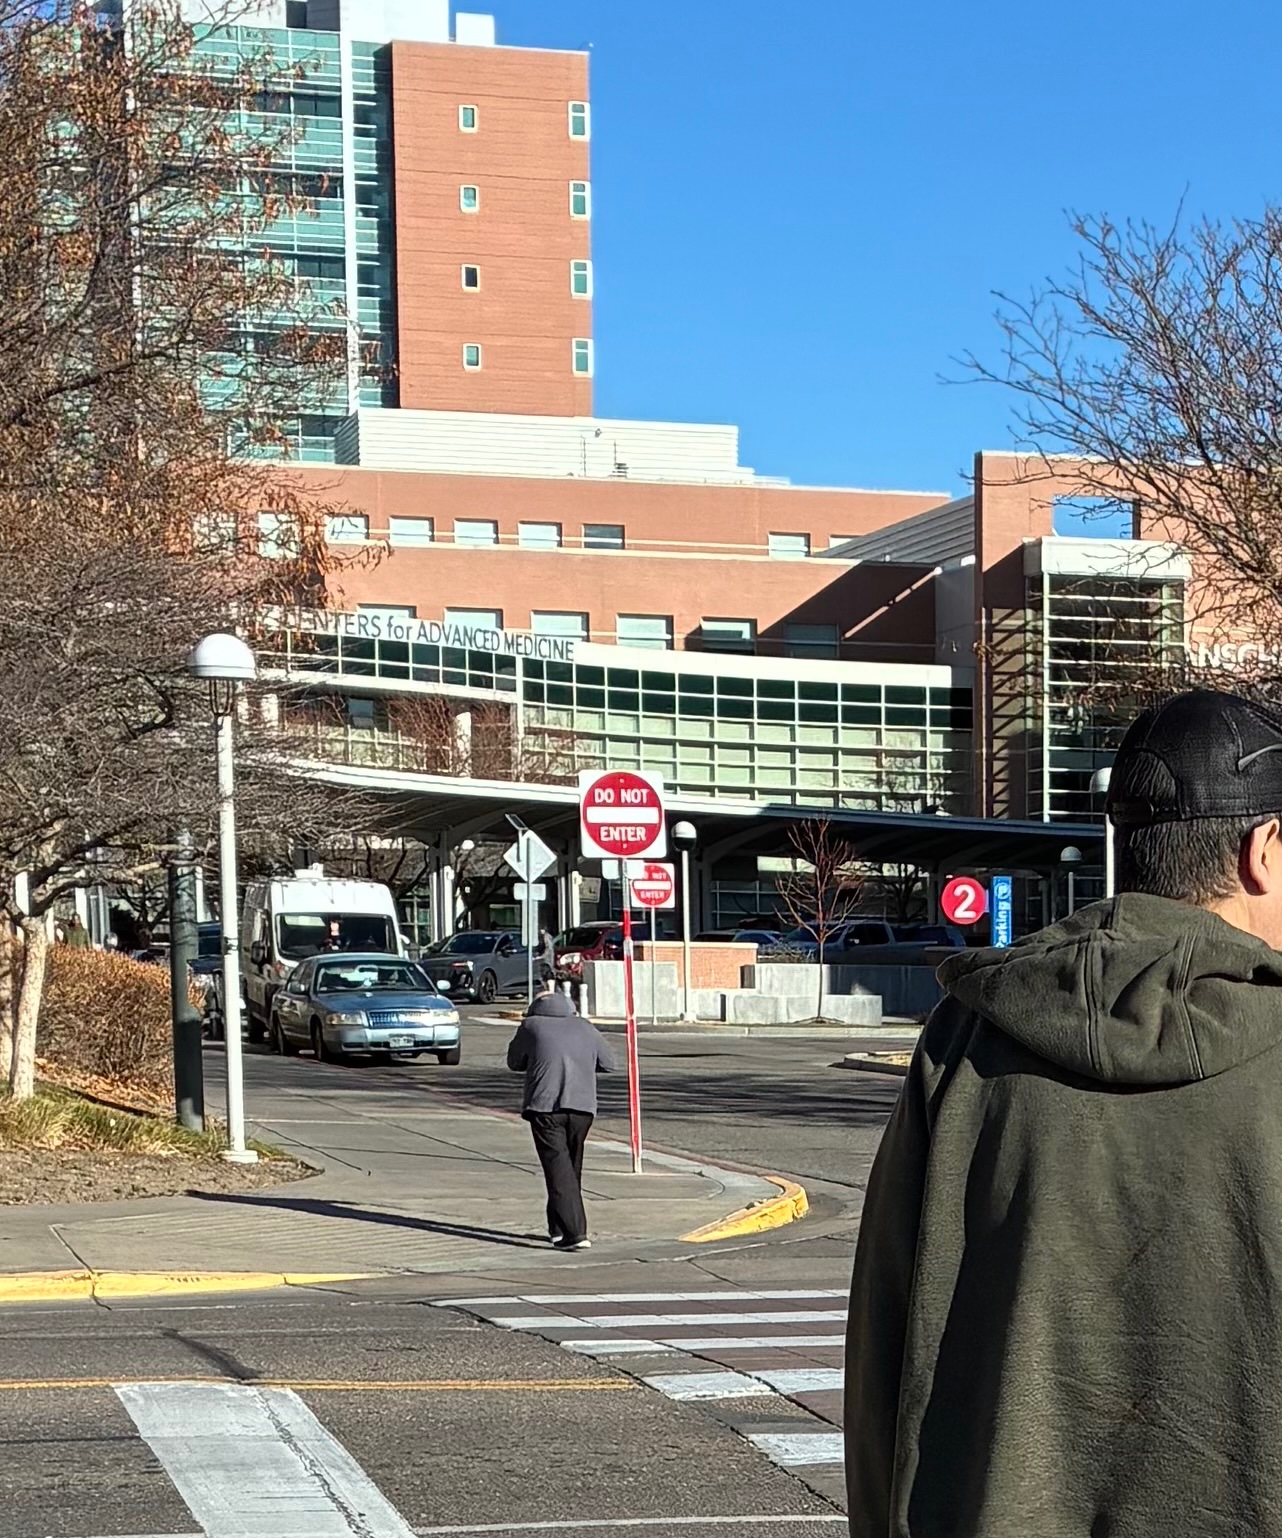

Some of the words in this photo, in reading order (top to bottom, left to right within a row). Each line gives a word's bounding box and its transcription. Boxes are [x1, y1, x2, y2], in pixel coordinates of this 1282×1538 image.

[387, 615, 413, 640] for
[416, 620, 500, 652] ADVANCED
[503, 631, 575, 662] MEDICINE
[594, 787, 615, 804] DO
[620, 788, 650, 804] NOT
[600, 826, 647, 842] ENTER
[640, 890, 665, 899] ENTER
[953, 884, 977, 919] 2
